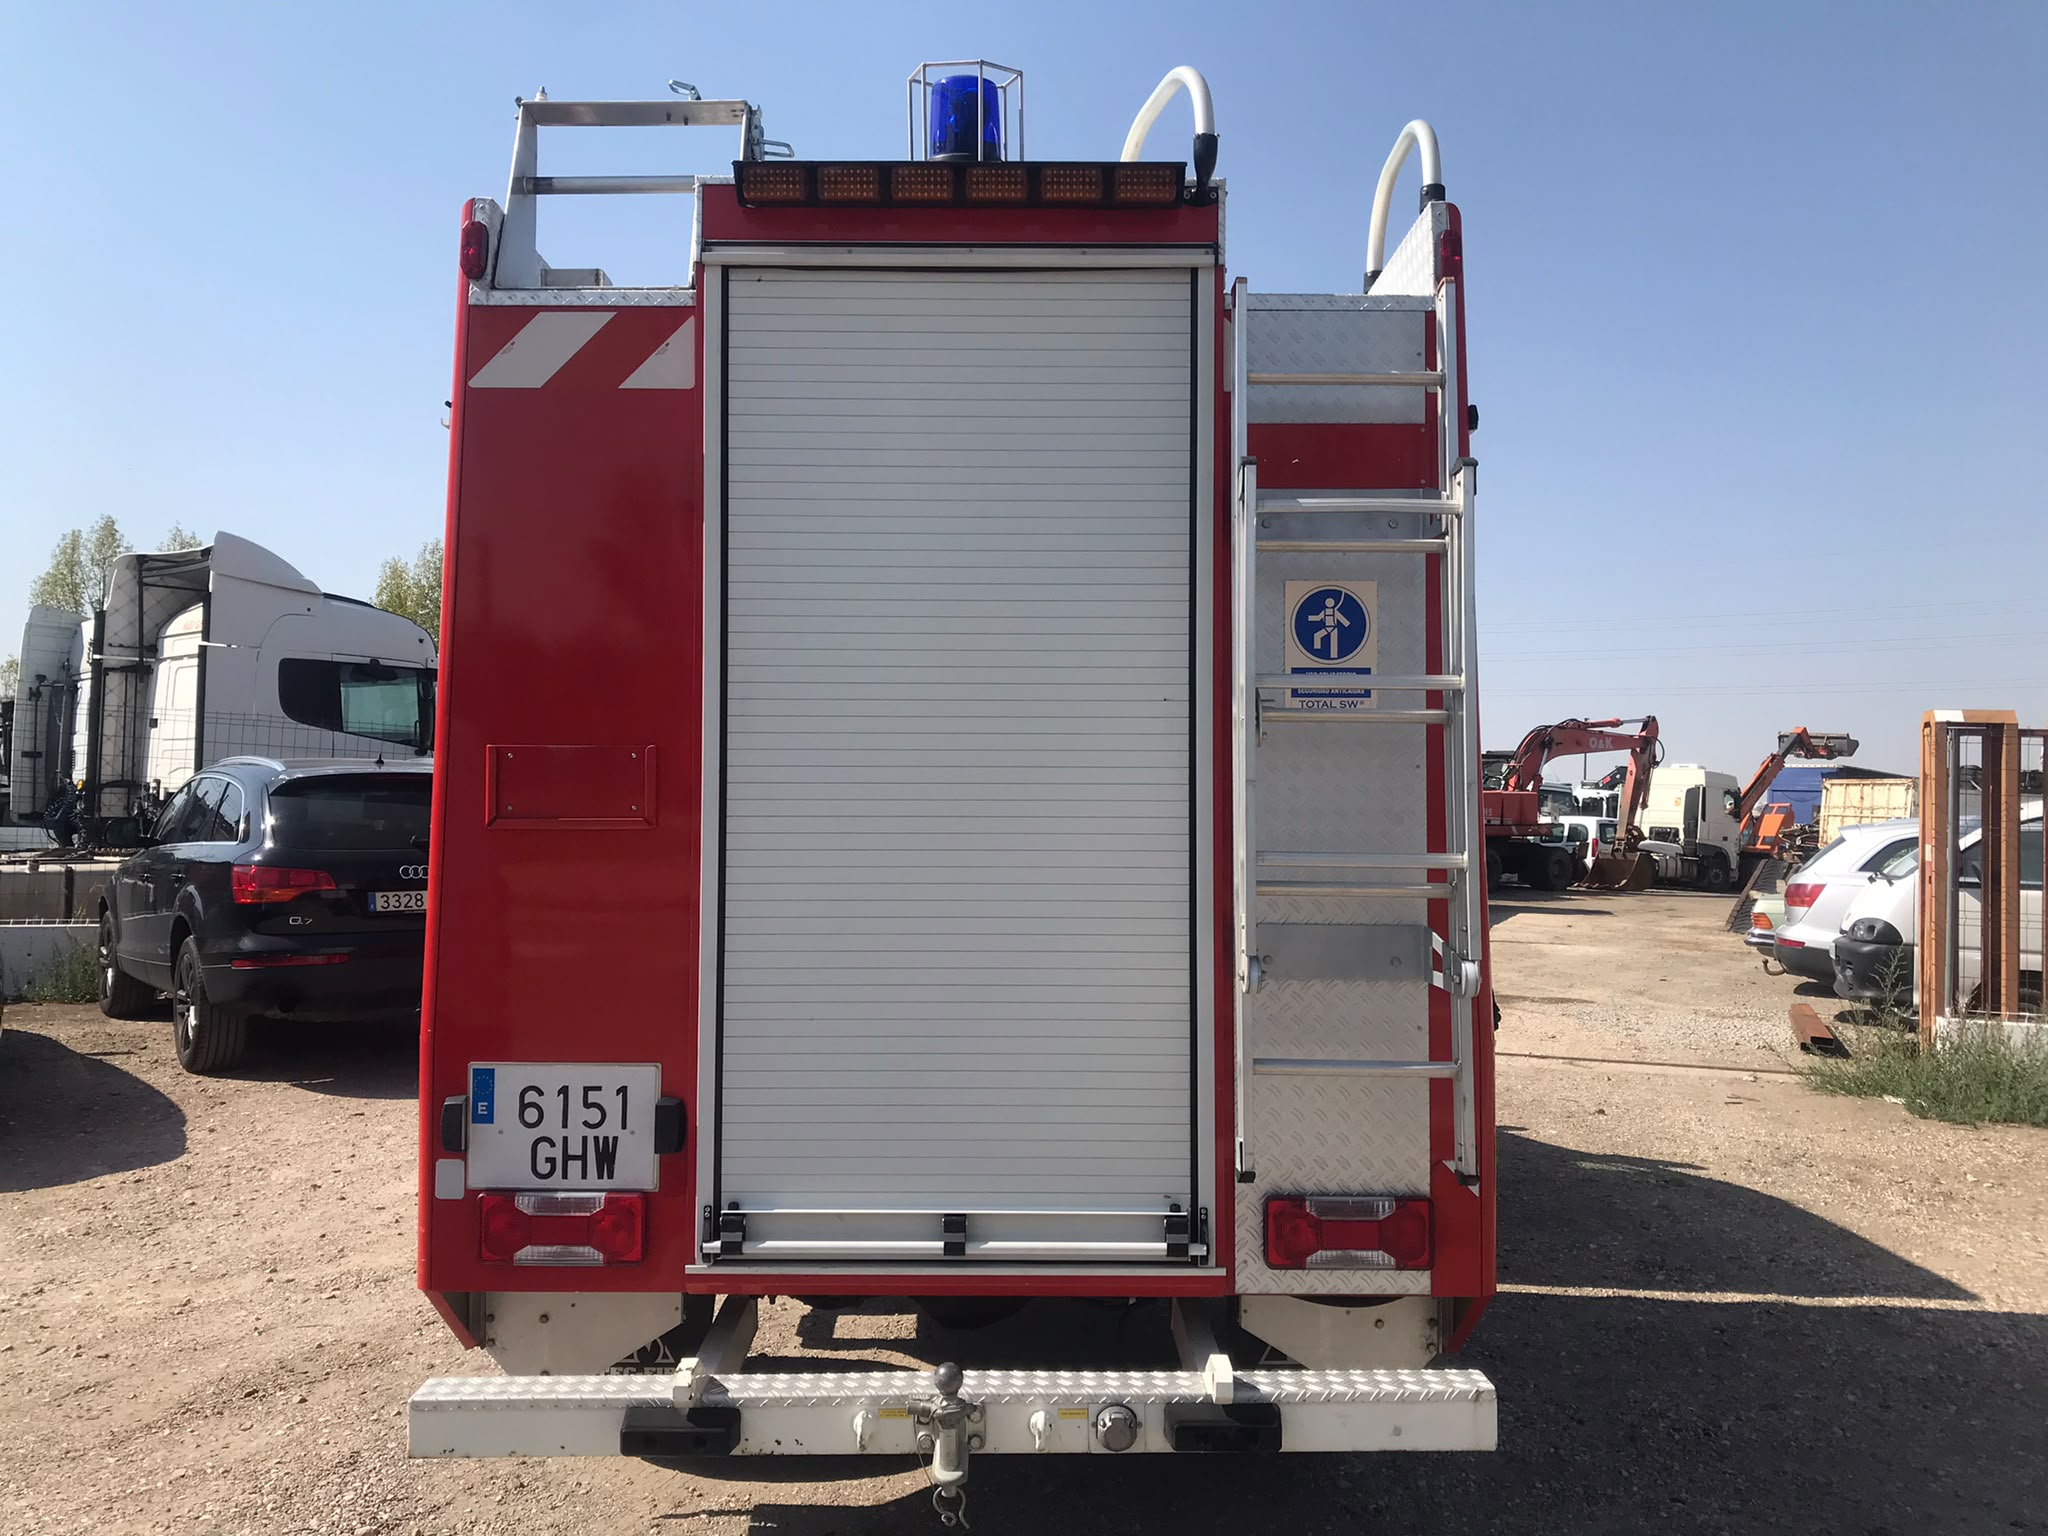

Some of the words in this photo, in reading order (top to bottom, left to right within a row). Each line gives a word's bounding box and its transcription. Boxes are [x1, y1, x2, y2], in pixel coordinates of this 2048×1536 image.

[1299, 700, 1337, 709] TOTAL
[1589, 737, 1613, 749] O&K
[380, 893, 424, 909] 3328
[289, 916, 313, 925] Q7
[478, 1102, 488, 1114] E
[518, 1085, 628, 1130] 6151
[530, 1135, 619, 1180] GHW
